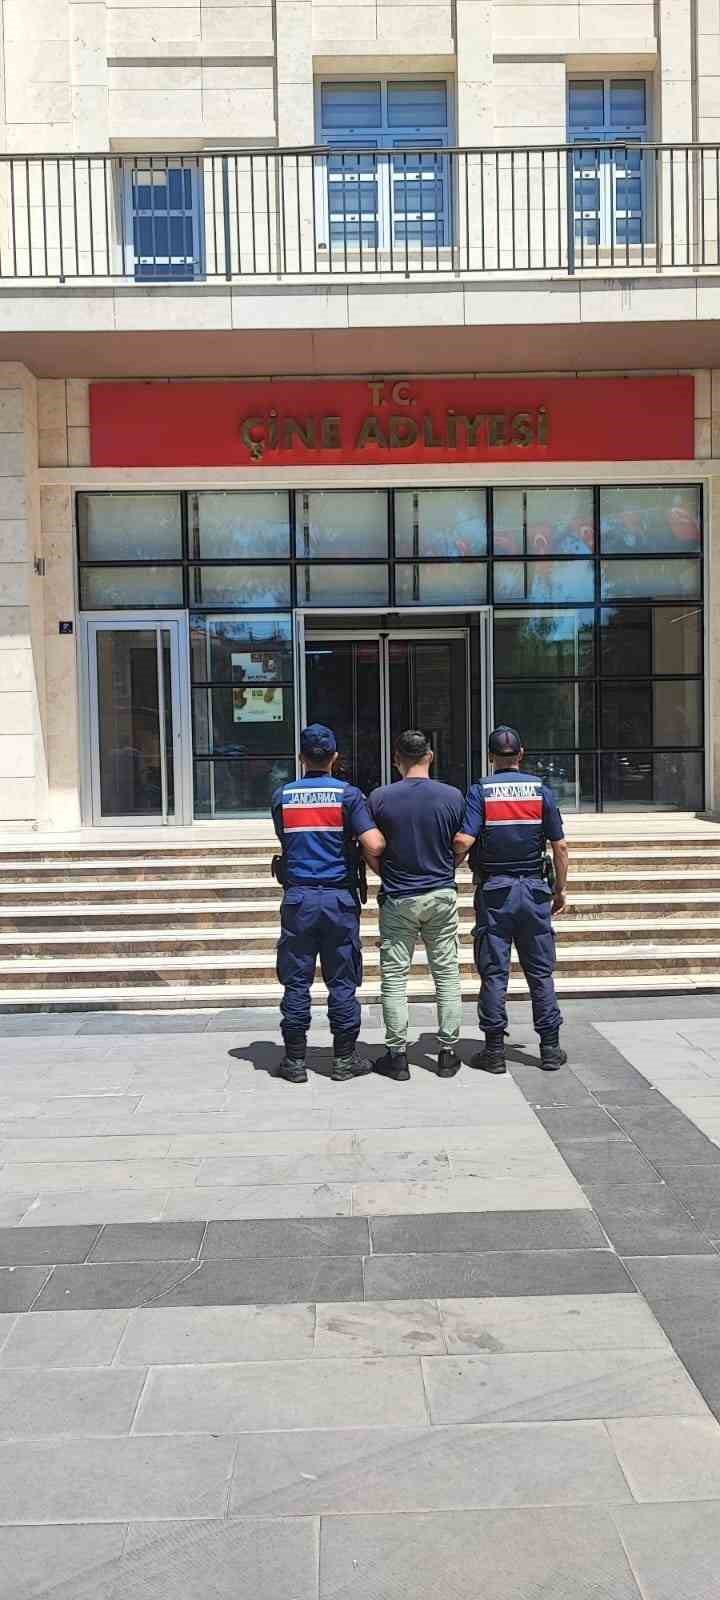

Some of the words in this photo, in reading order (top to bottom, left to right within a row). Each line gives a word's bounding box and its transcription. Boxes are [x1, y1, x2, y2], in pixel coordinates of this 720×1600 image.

[240, 409, 342, 462] ÇİNE
[355, 406, 549, 451] ADLİYESİ
[289, 791, 337, 804] JANDARMA
[489, 785, 537, 798] JANDARMA
